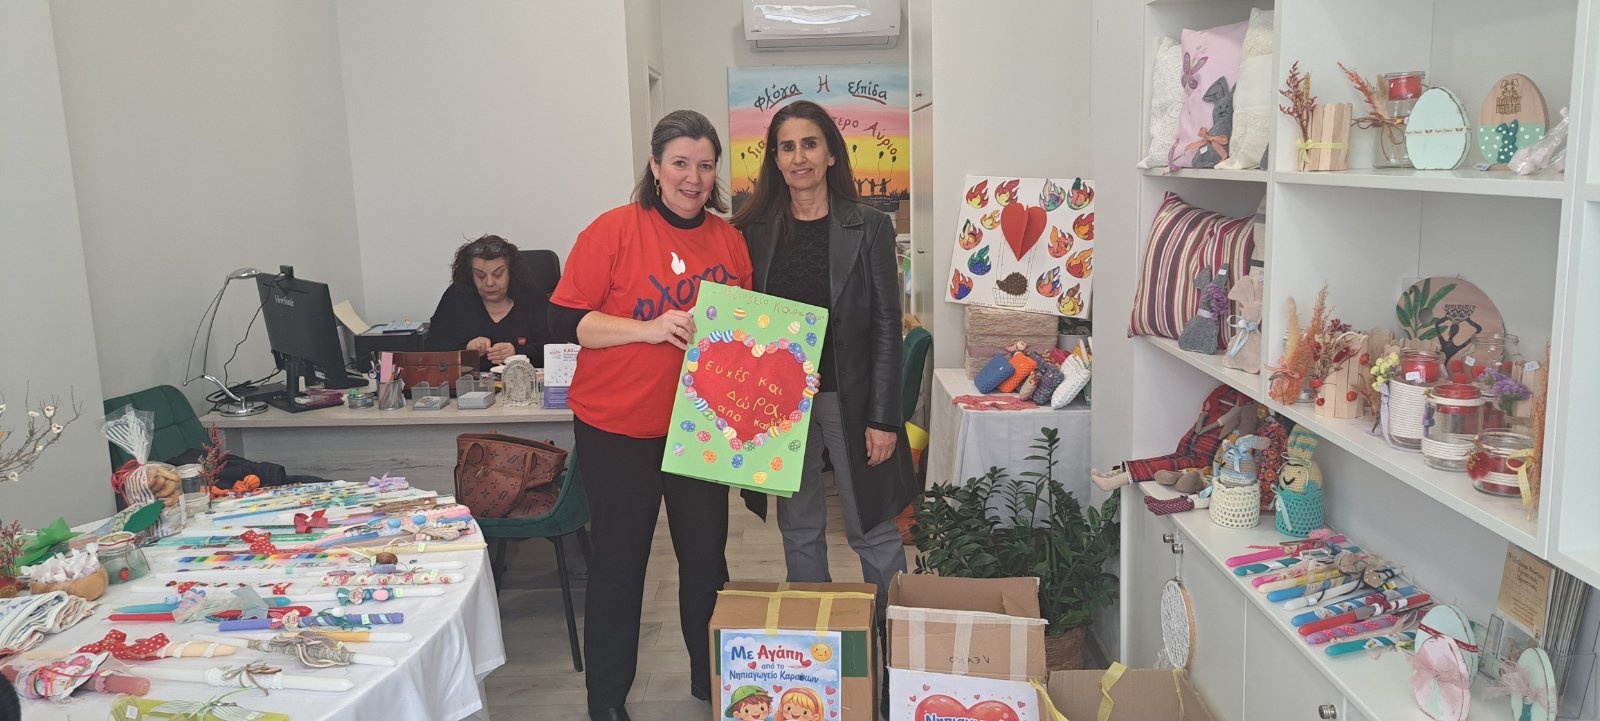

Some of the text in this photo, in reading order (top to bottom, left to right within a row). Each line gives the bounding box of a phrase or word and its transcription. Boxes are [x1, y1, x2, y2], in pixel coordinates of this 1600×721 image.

[731, 644, 806, 663] Με Αγάπη
[729, 670, 778, 682] Νηπιαγωγείο
